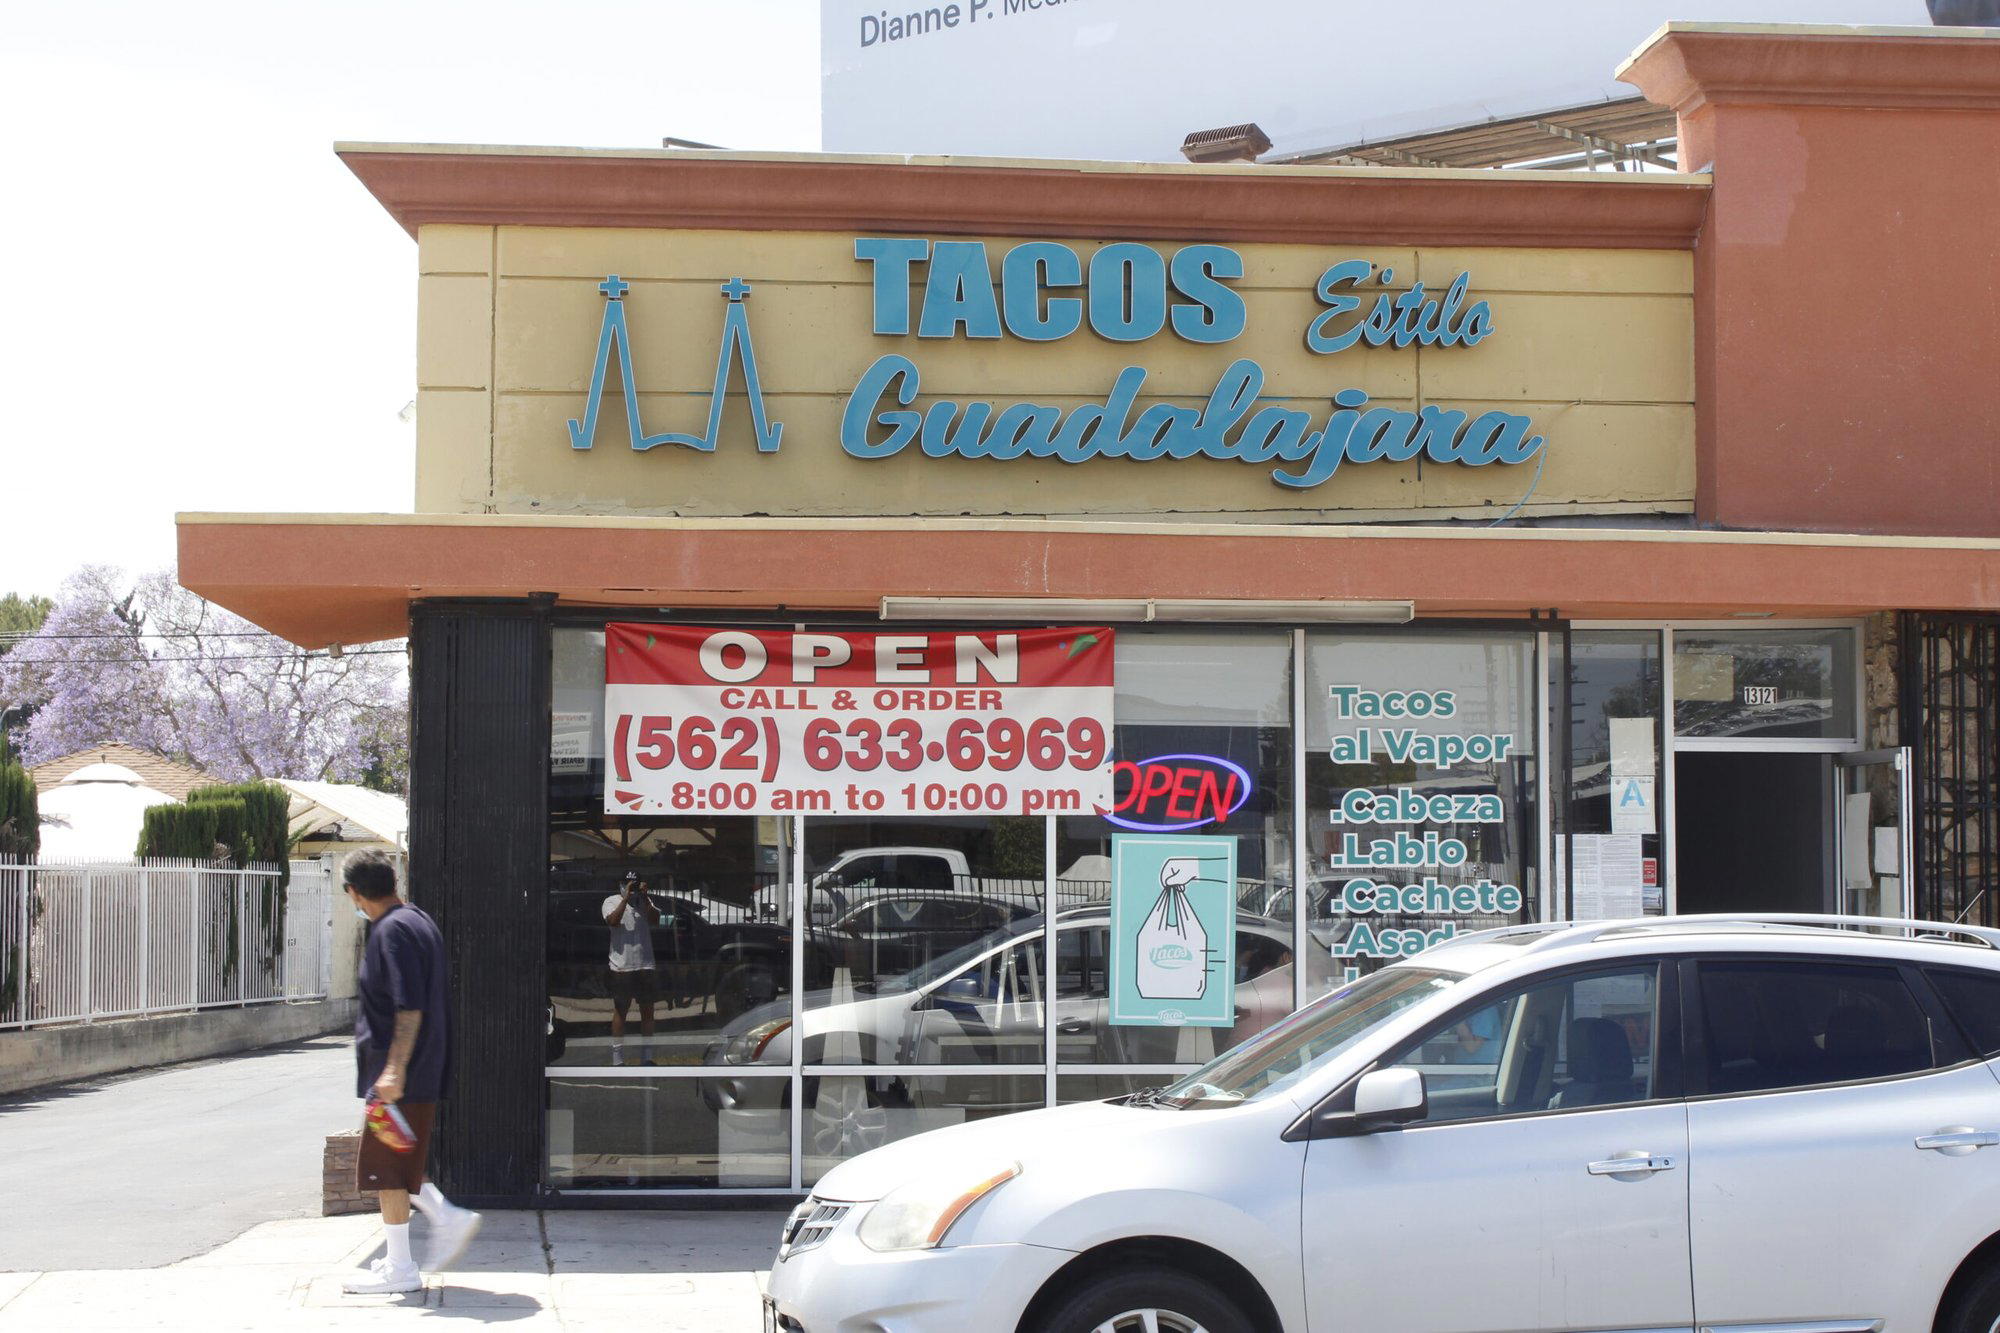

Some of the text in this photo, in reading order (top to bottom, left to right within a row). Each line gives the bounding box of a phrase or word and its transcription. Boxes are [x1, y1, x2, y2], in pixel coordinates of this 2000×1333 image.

[861, 4, 960, 47] Dianne
[970, 0, 993, 23] P.
[854, 237, 1247, 344] TACOS
[1305, 258, 1496, 355] Estilo
[839, 354, 1546, 488] Guadalajara
[700, 631, 1020, 684] OPEN
[720, 688, 1003, 712] CALL & ORDER
[1329, 684, 1456, 719] Tacos
[1745, 687, 1777, 704] 13121
[613, 714, 780, 782] (562)
[1330, 728, 1513, 769] al Vapor
[671, 781, 1081, 816] 8:00 am to 10:00 pm
[1113, 760, 1238, 823] OPEN
[1620, 780, 1645, 807] A
[1331, 920, 1475, 959] .Asad
